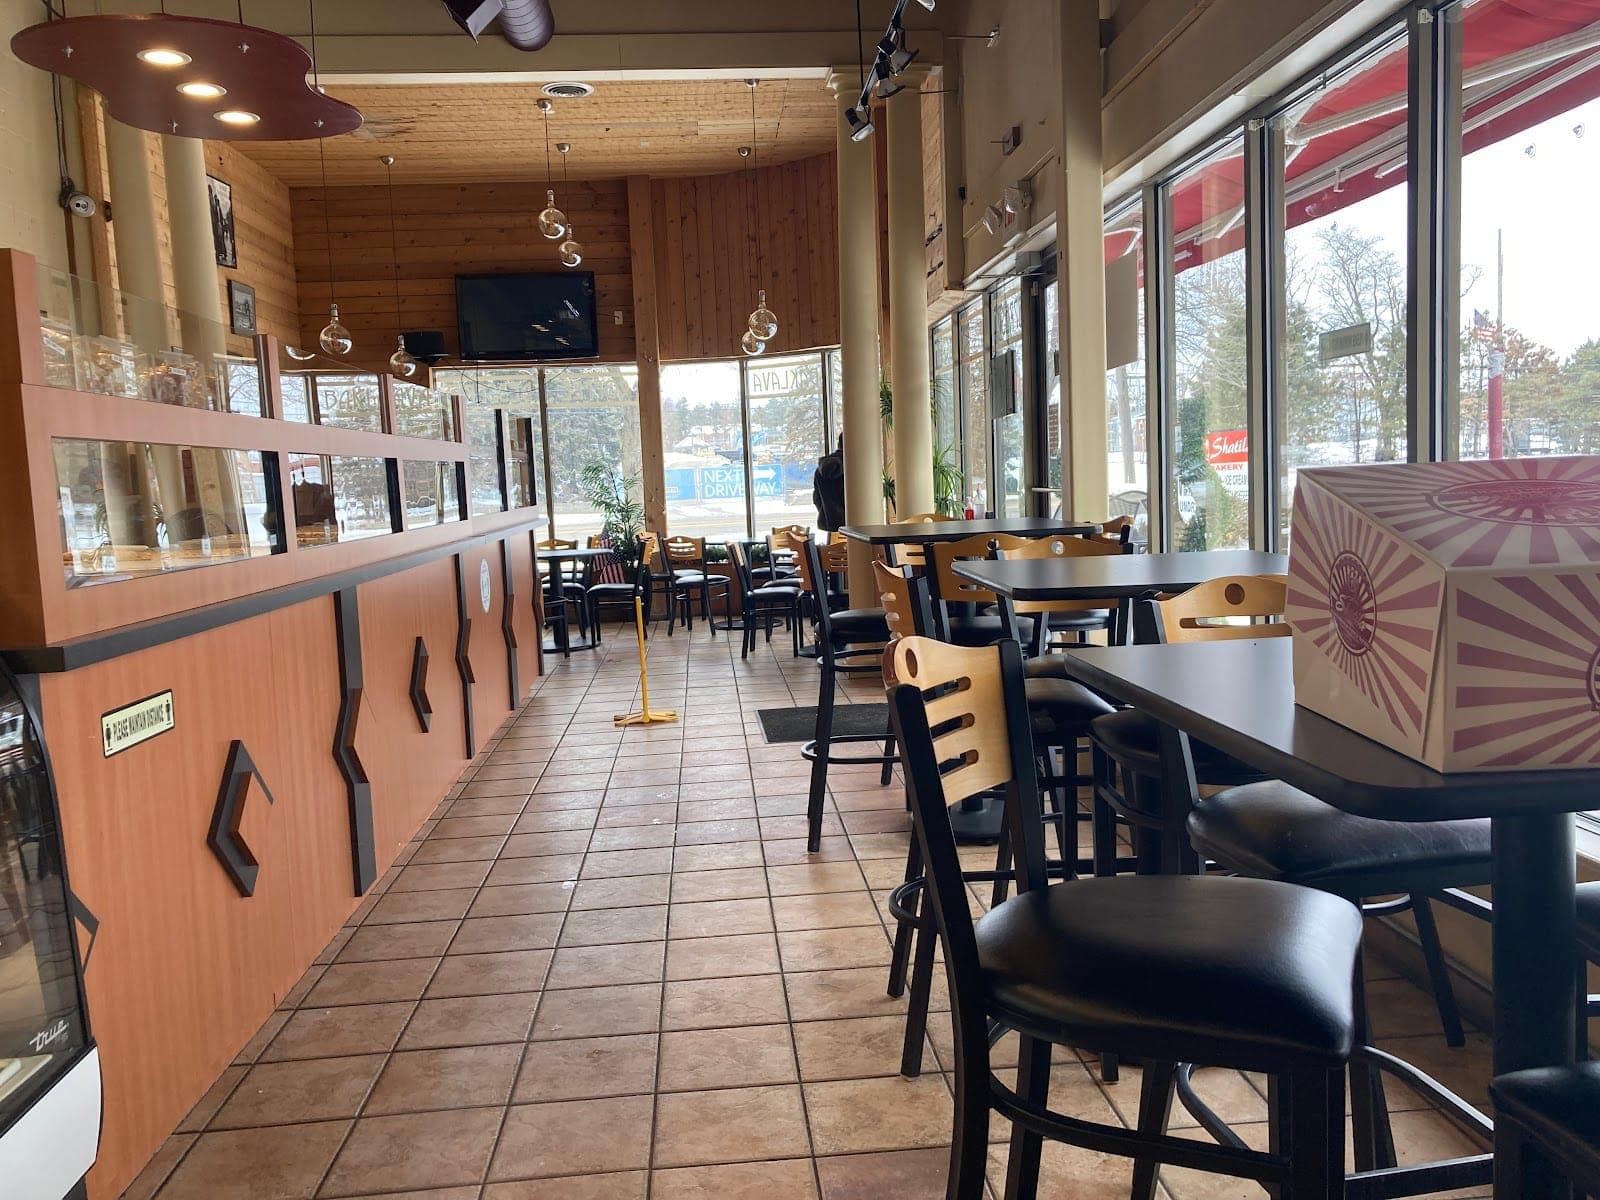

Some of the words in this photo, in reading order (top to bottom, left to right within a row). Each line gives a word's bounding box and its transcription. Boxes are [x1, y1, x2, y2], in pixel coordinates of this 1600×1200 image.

[703, 469, 743, 483] NEXT
[1215, 463, 1243, 471] AKERY
[113, 717, 128, 741] PLEASE
[29, 1019, 70, 1052] true
